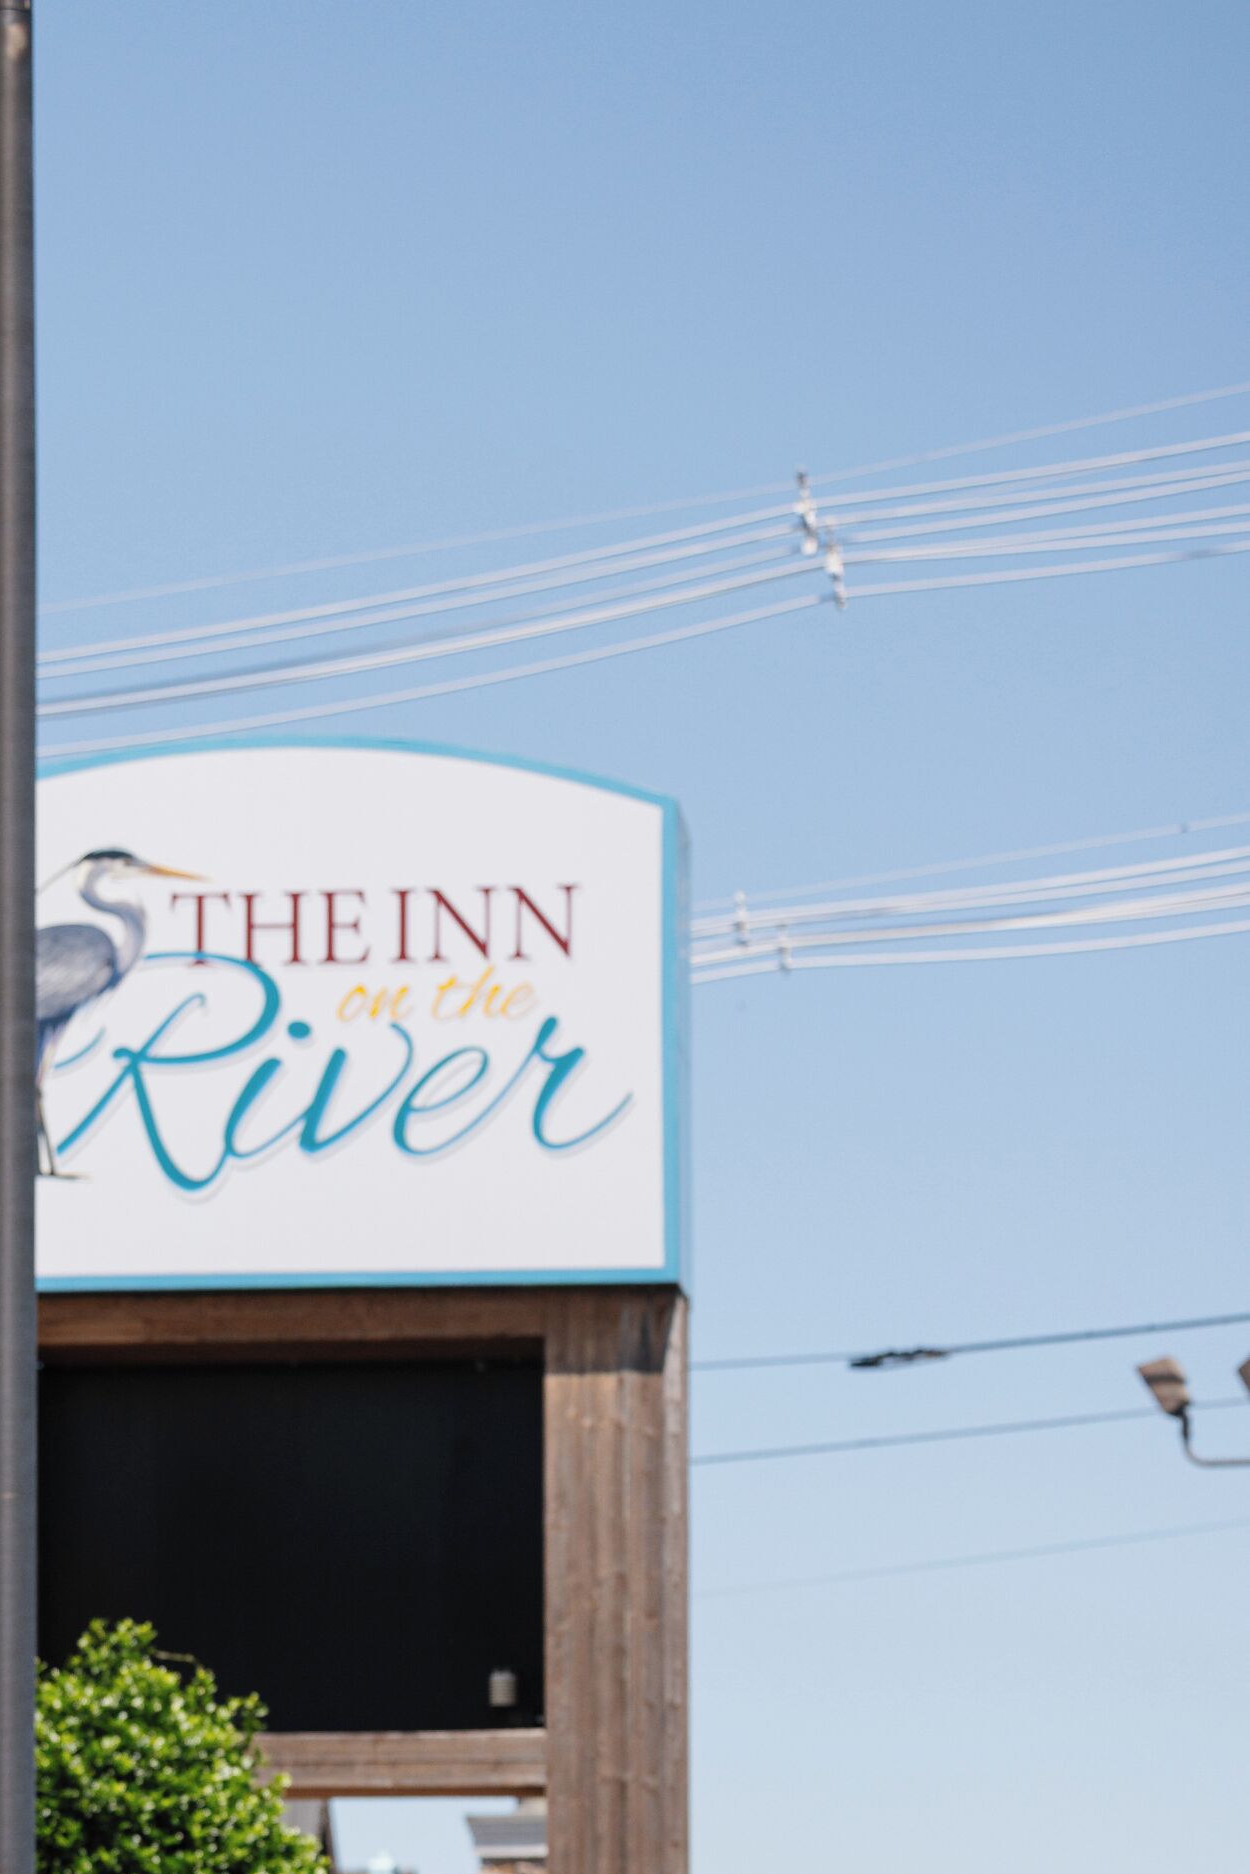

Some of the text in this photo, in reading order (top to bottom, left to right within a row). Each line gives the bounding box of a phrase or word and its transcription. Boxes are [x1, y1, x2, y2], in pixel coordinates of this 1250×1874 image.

[169, 883, 578, 968] THE INN
[336, 963, 538, 1023] on the
[52, 951, 634, 1191] River
